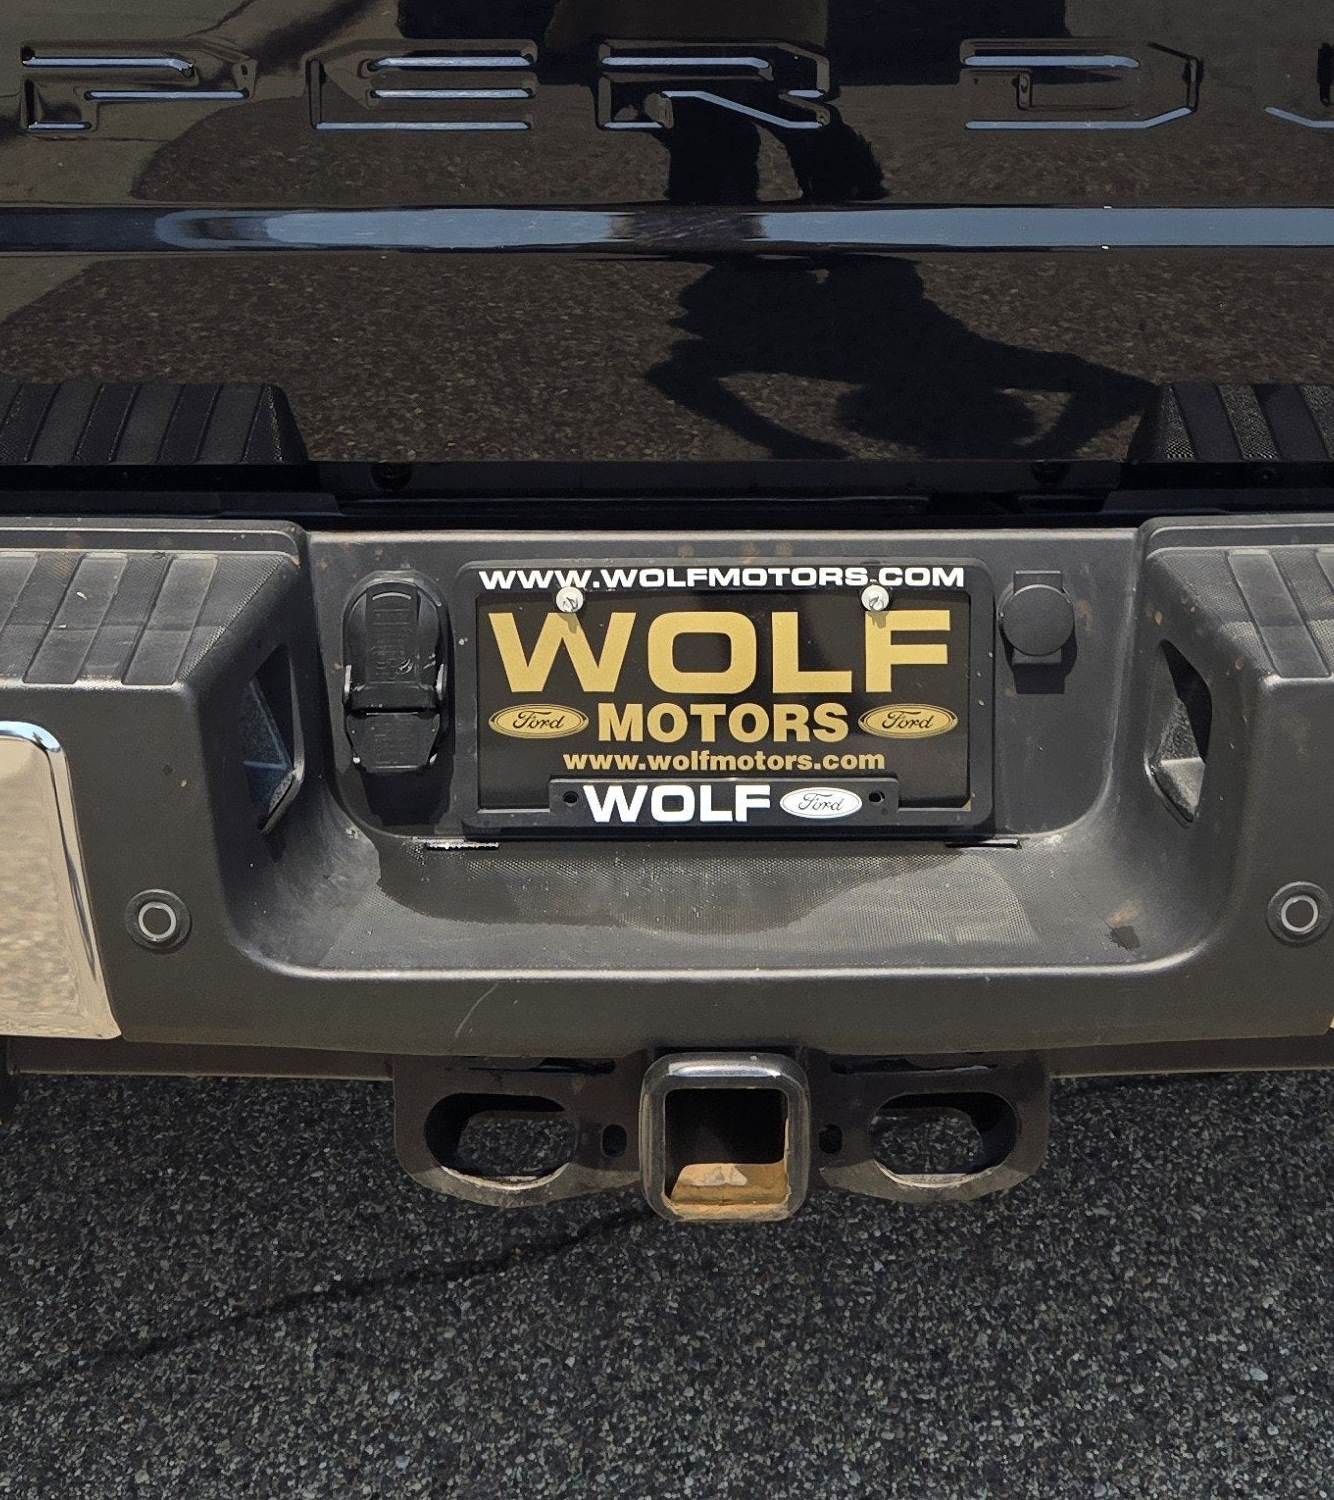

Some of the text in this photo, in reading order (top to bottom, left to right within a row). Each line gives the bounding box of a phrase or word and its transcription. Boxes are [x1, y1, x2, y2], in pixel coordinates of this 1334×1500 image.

[478, 566, 965, 591] WWW.WOLFMOTORS.COM
[488, 609, 951, 694] WOLF
[512, 710, 567, 730] Ford
[597, 702, 849, 743] MOTORS
[881, 710, 934, 730] Ford
[562, 750, 886, 771] www.wolfmotors.com
[582, 784, 771, 823] WOLF
[798, 792, 845, 811] Ford
